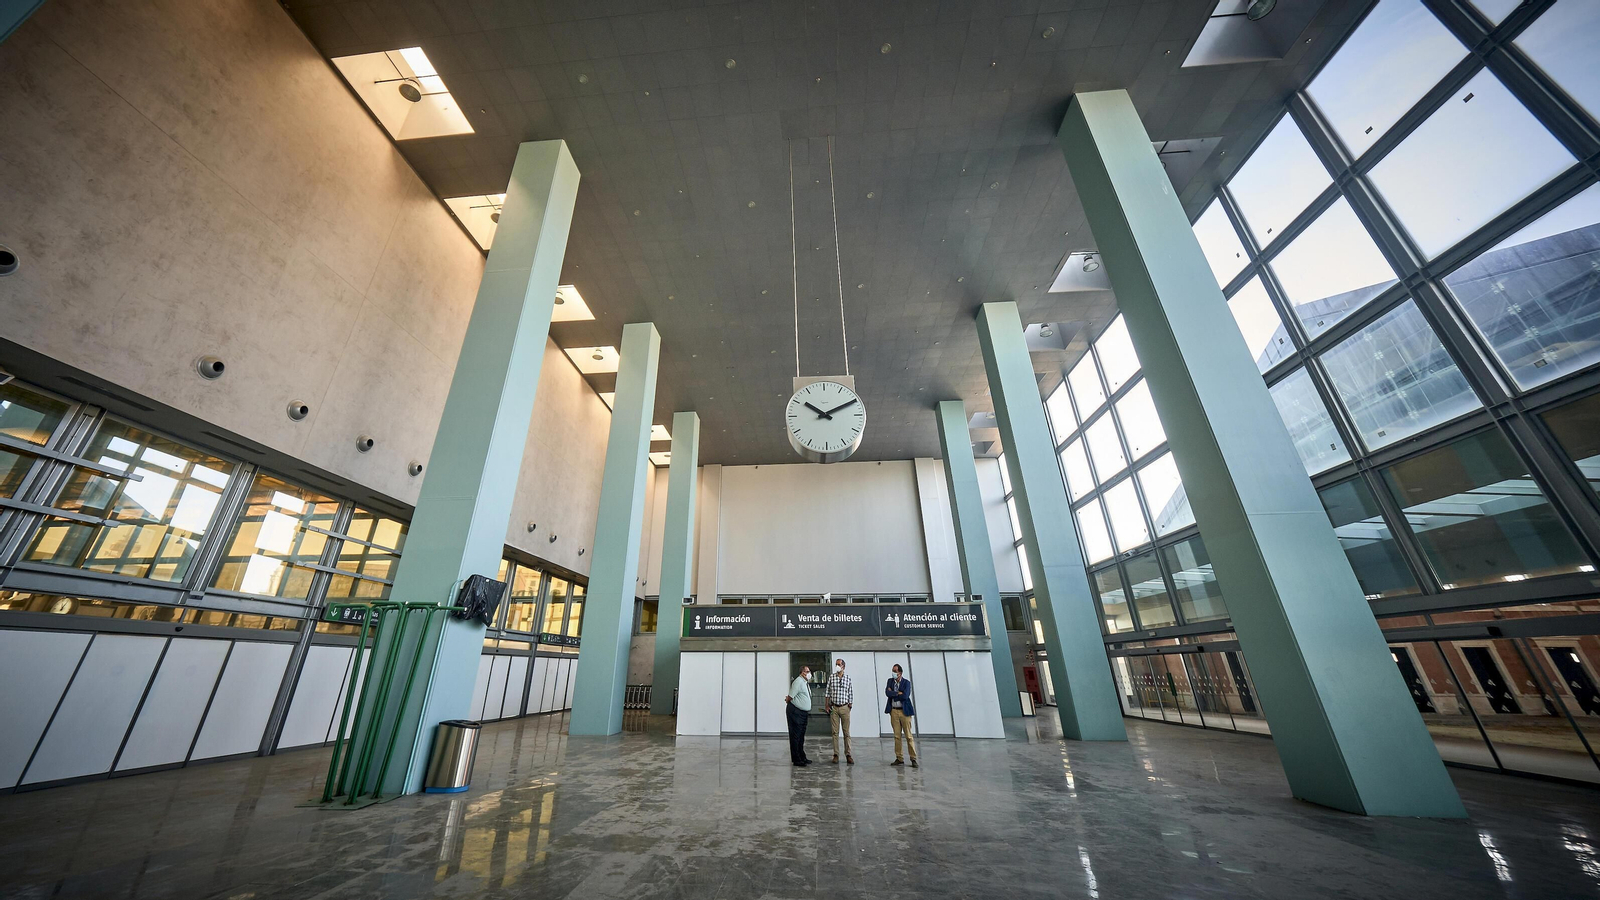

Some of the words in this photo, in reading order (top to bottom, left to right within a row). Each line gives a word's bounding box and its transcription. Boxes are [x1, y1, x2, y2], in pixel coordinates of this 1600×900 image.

[705, 614, 751, 623] Información
[798, 614, 820, 622] Venta
[821, 613, 832, 622] de
[834, 613, 863, 622] billetes
[903, 612, 938, 621] Atención
[940, 612, 948, 621] al
[949, 612, 977, 621] cliente
